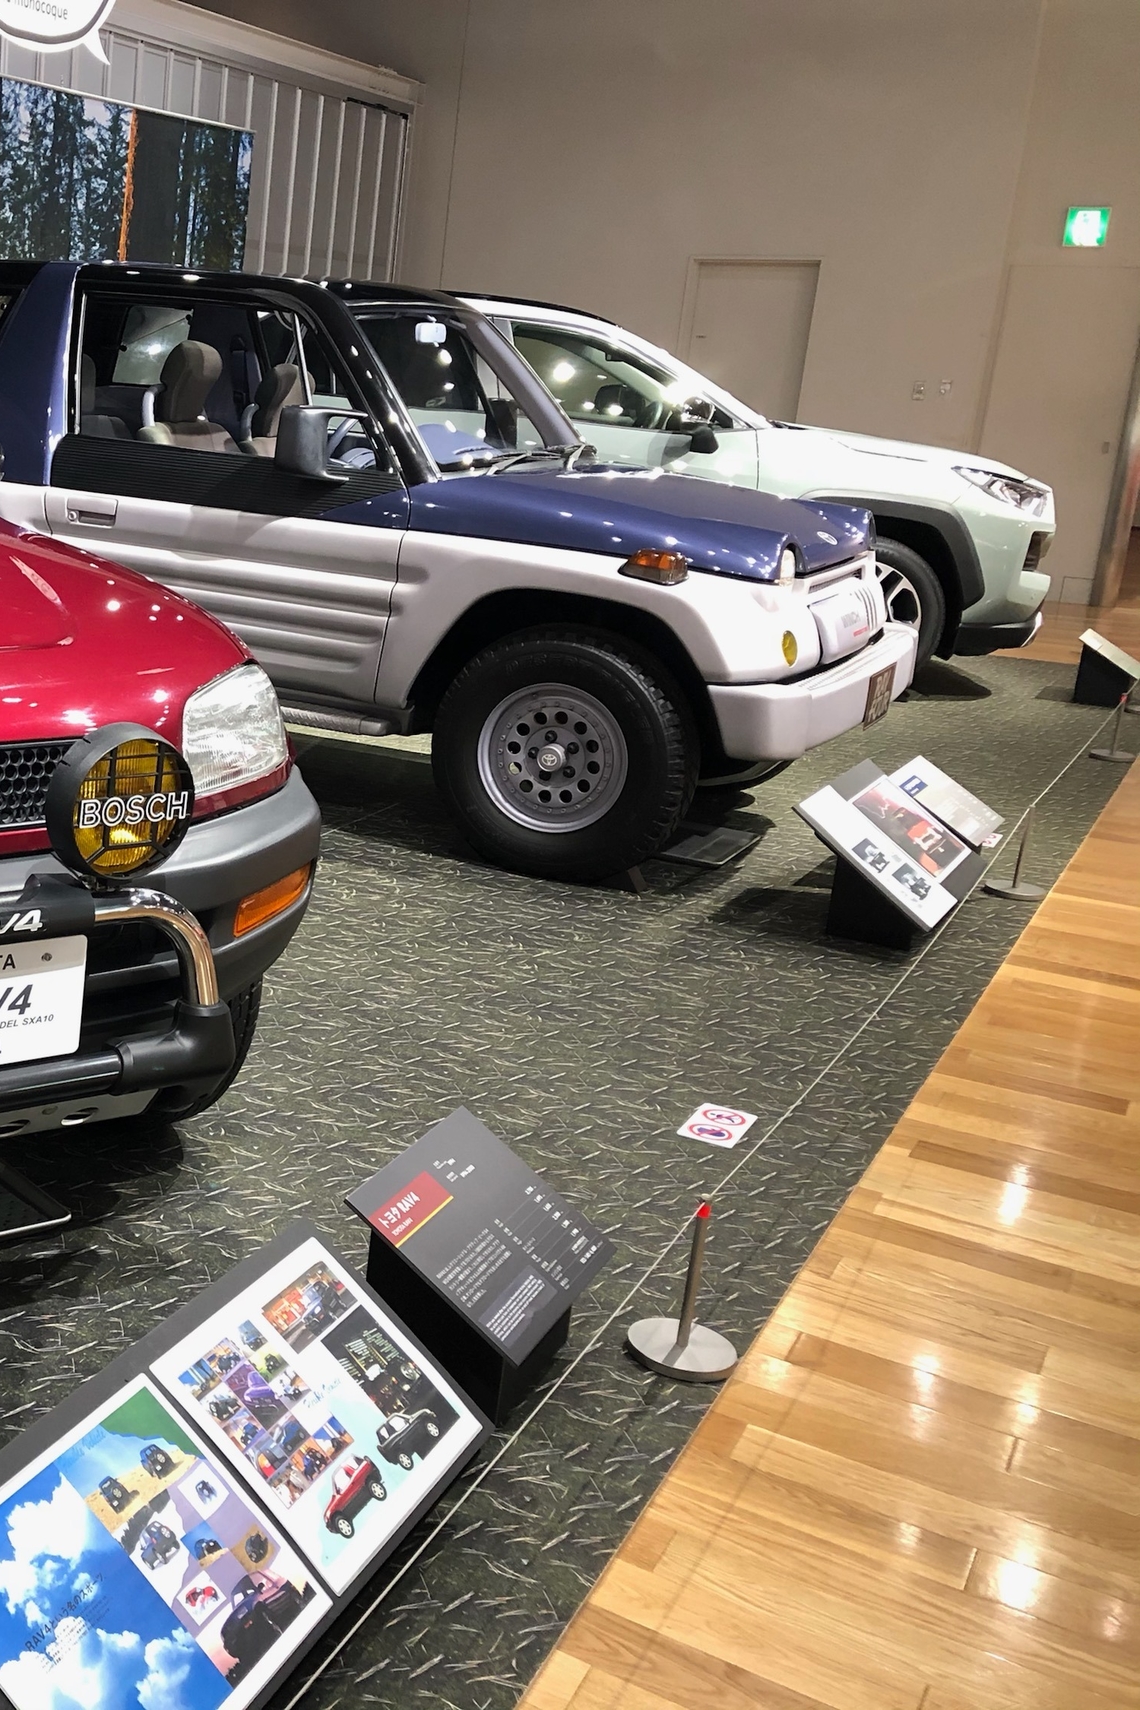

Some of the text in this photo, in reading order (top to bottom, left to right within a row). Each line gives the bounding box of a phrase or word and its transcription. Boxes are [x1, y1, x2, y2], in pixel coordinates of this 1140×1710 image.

[79, 791, 189, 829] BOSCH
[22, 1014, 55, 1026] SXA10
[378, 1191, 421, 1229] トヨタ RAV4
